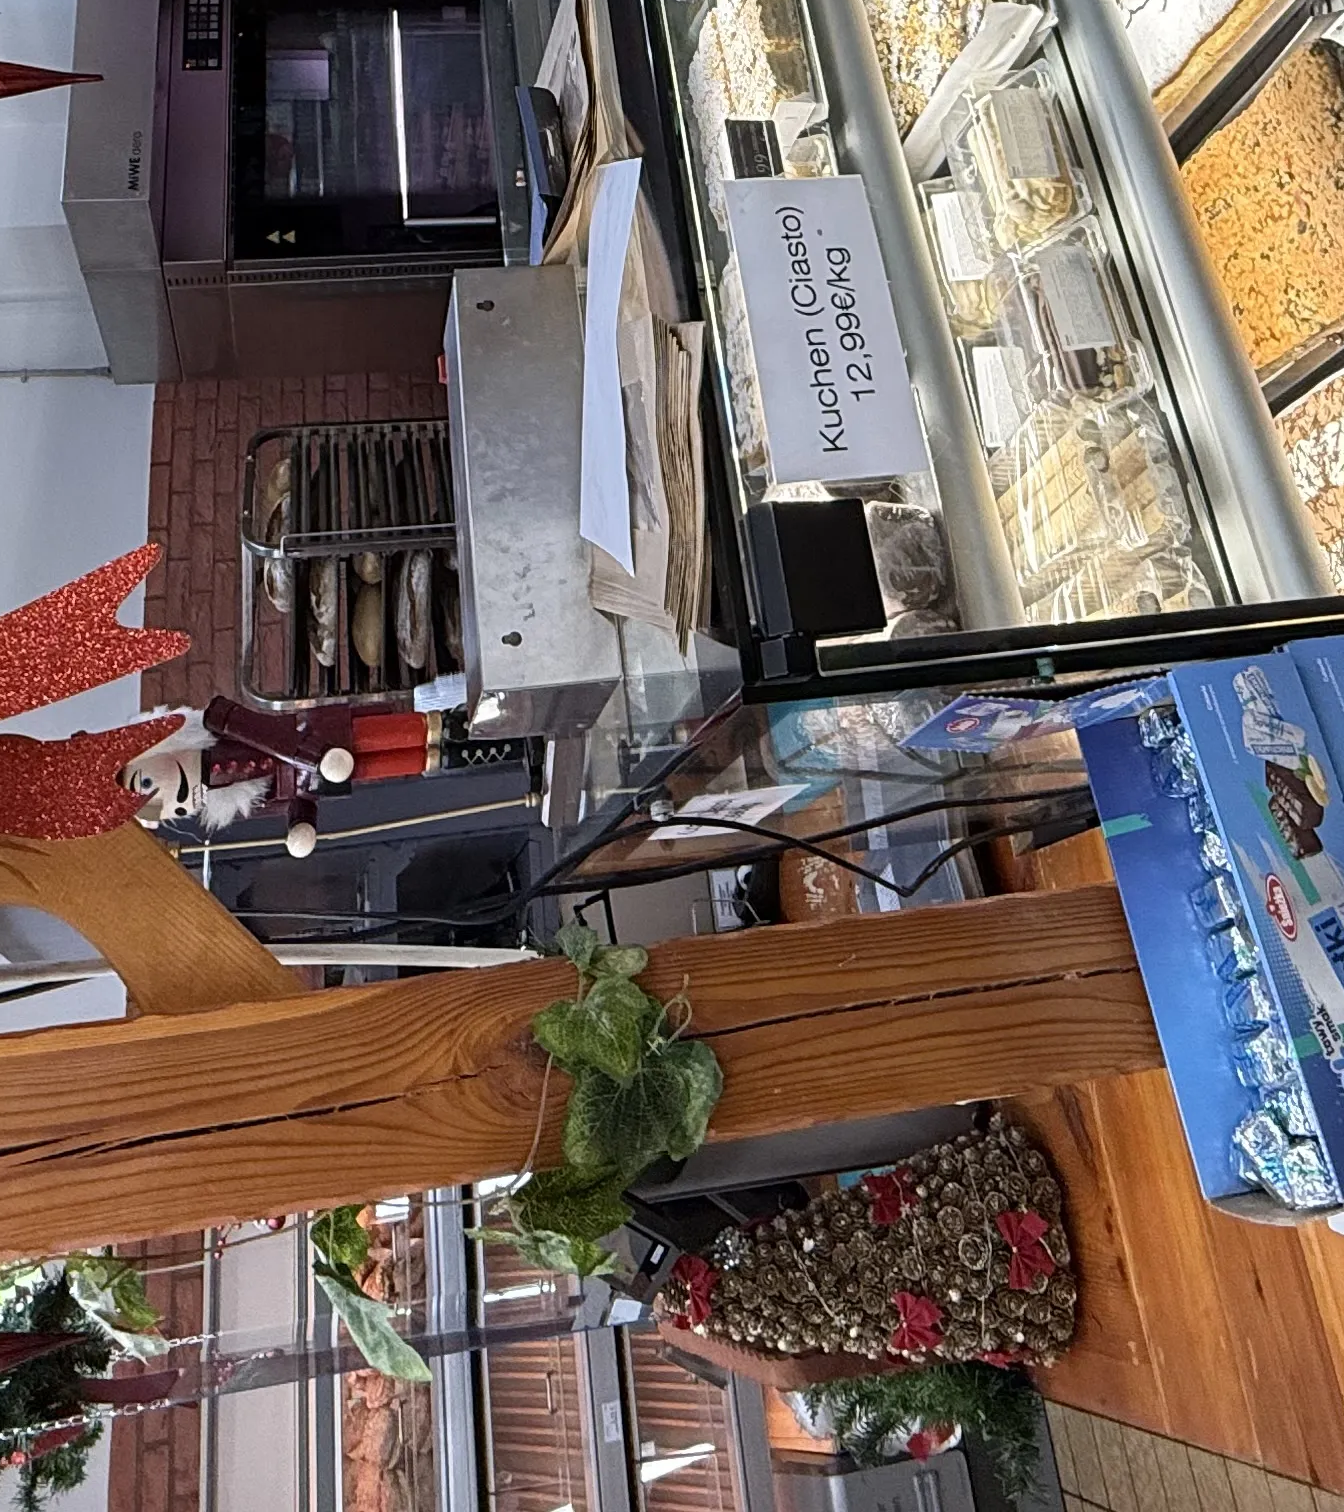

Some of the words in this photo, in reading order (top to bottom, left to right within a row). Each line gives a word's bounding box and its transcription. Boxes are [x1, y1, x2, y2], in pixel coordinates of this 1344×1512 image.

[775, 206, 824, 316] (Ciasto)
[825, 247, 875, 402] 12,99€/kg
[805, 328, 848, 453] Kuchen
[1312, 1020, 1336, 1056] towy
[1318, 1003, 1342, 1042] smak
